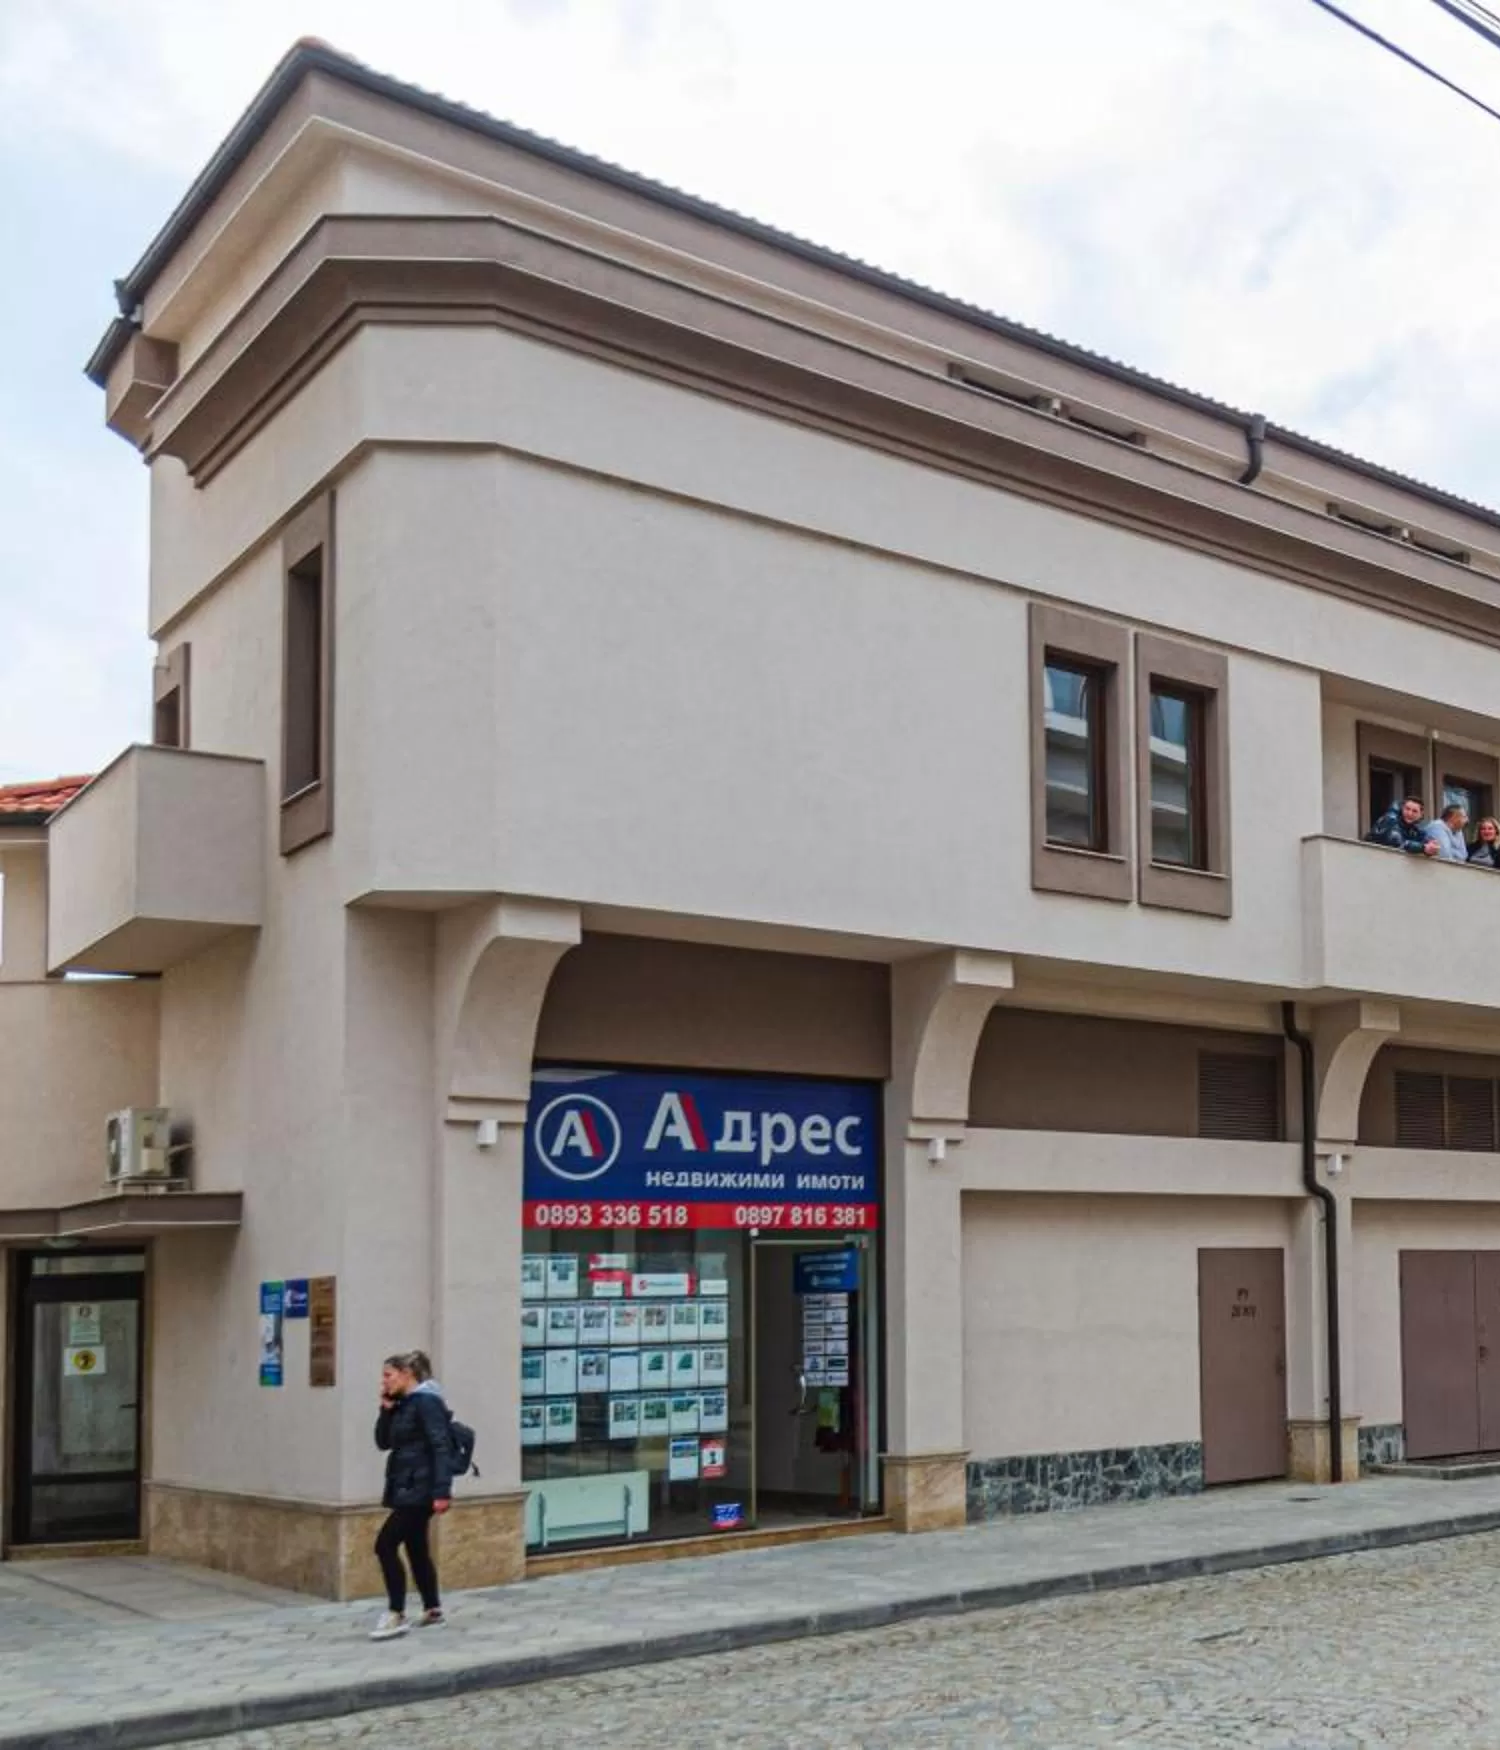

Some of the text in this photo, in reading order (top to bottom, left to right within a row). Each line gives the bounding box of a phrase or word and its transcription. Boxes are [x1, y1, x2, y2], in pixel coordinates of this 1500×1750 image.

[643, 1092, 862, 1166] Адрес
[645, 1169, 865, 1190] недвижими имоти
[535, 1204, 688, 1226] 0893 336 518
[734, 1205, 866, 1226] 0897 816 381
